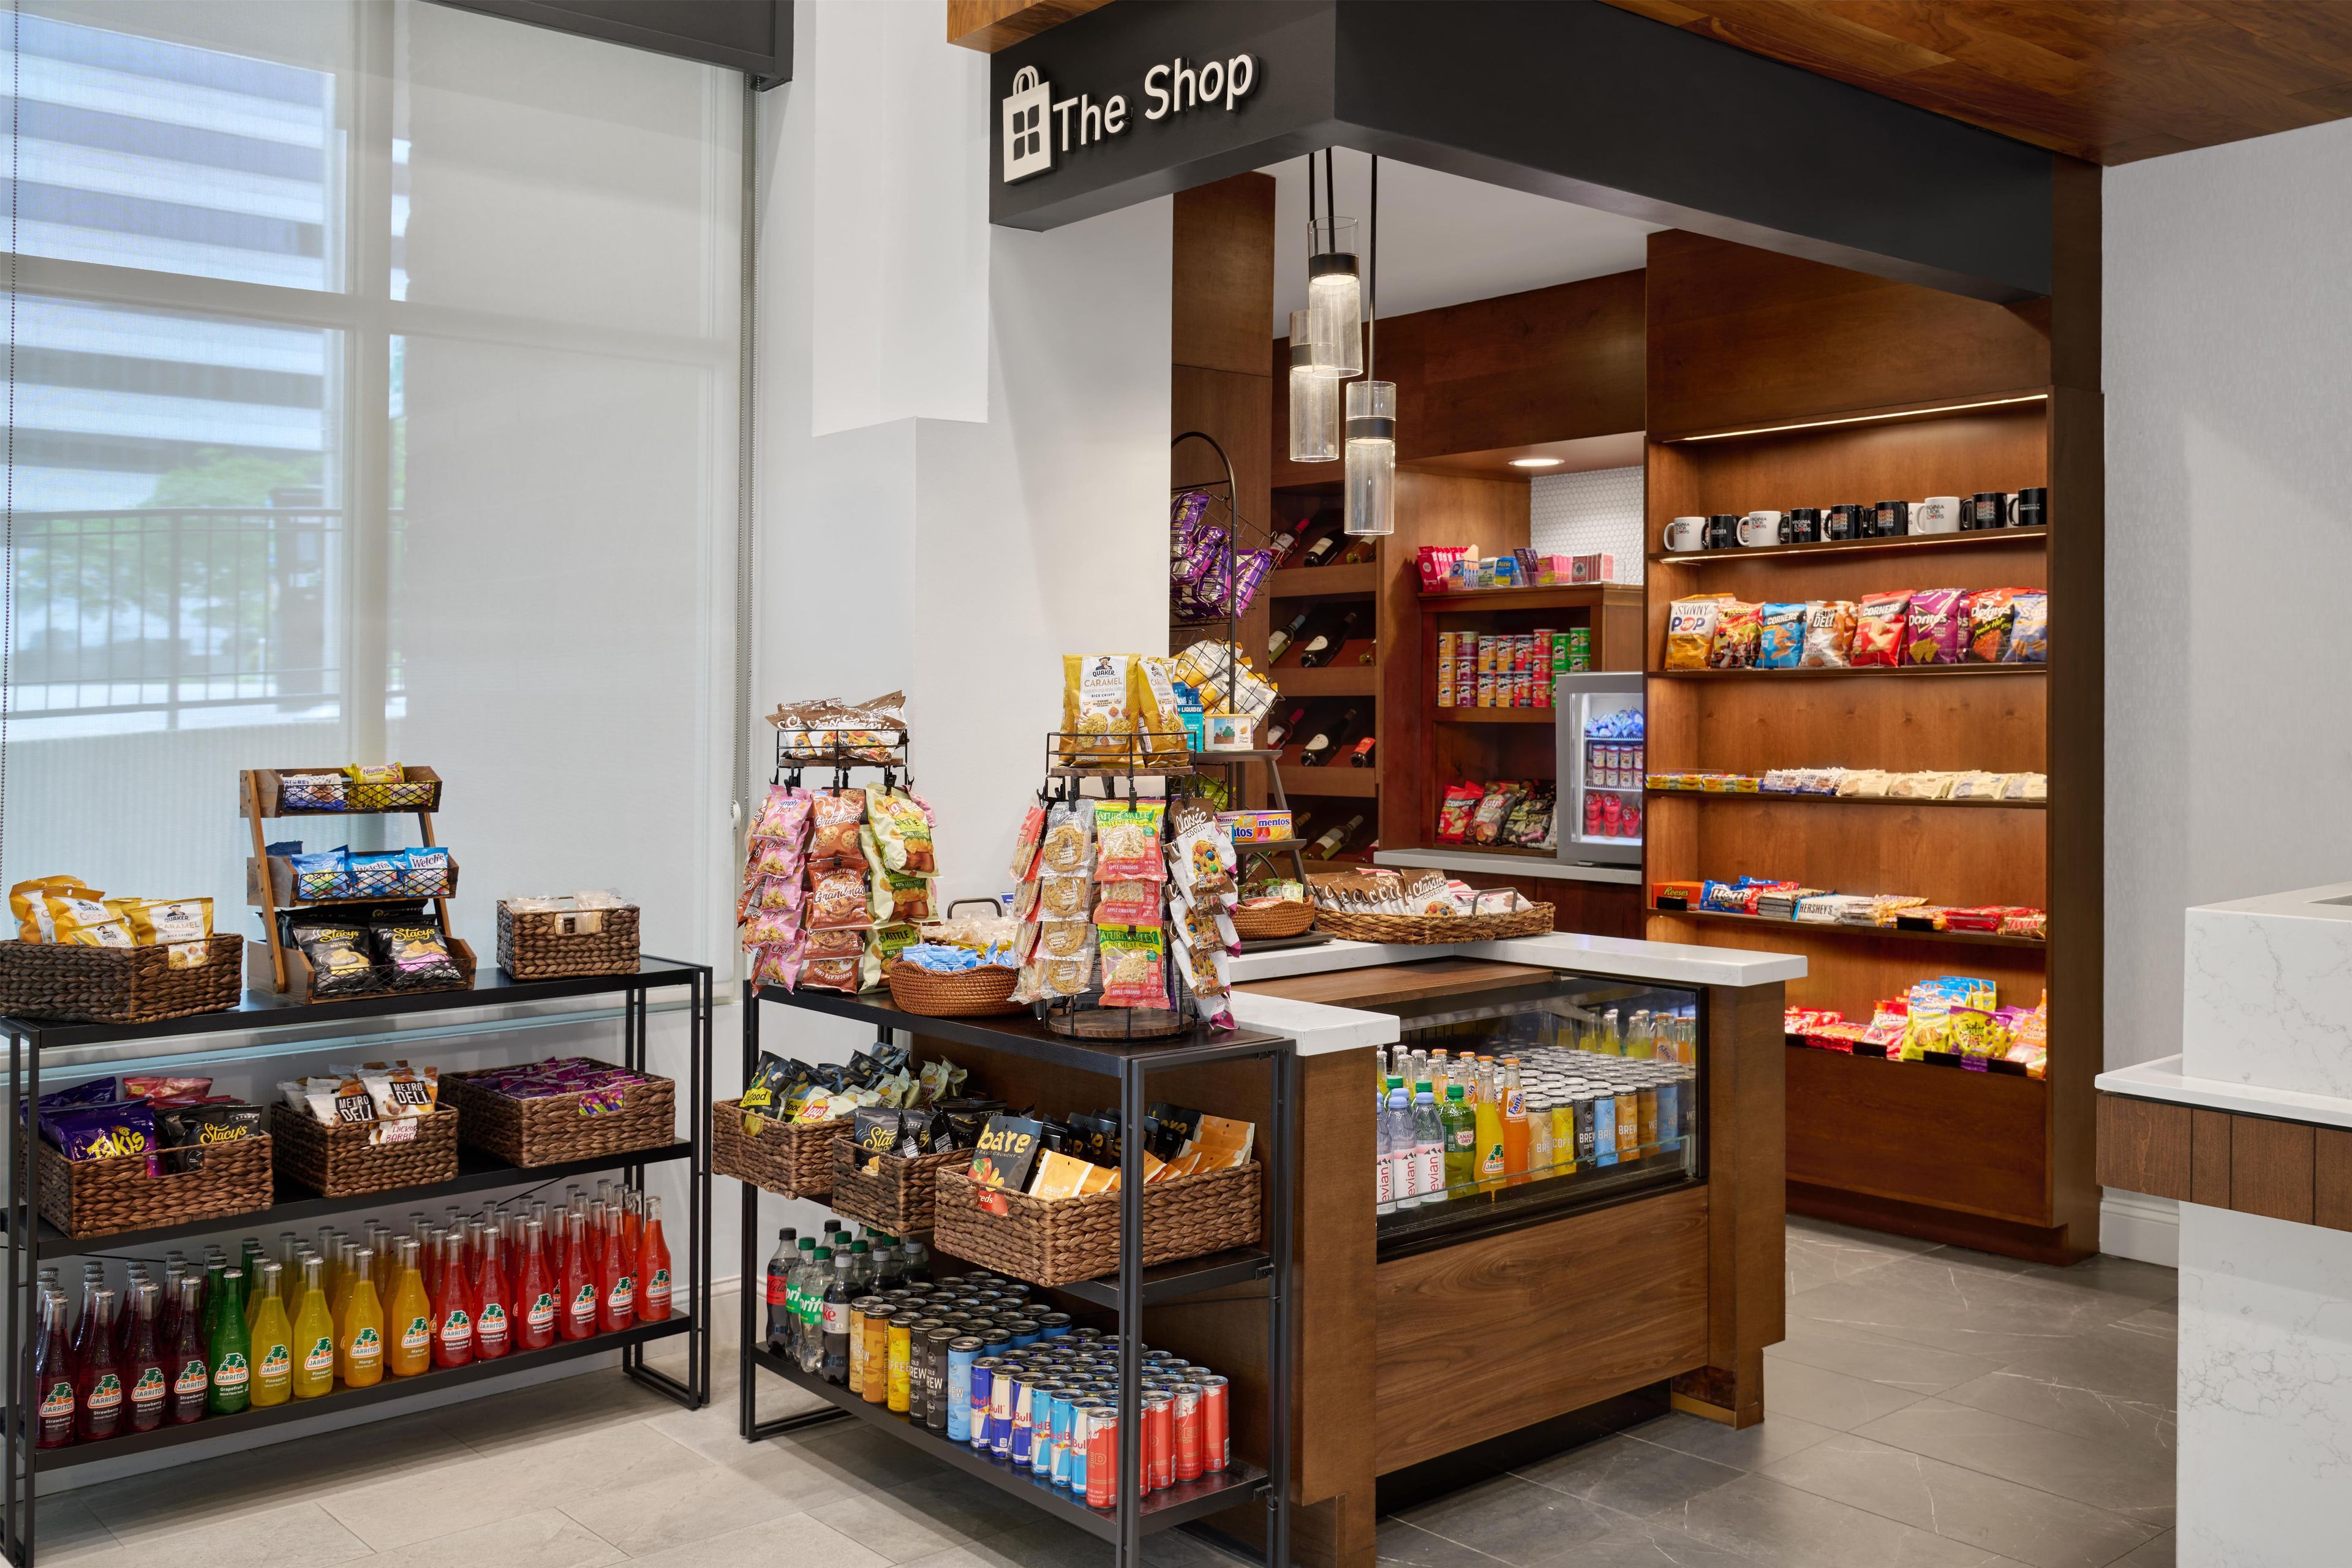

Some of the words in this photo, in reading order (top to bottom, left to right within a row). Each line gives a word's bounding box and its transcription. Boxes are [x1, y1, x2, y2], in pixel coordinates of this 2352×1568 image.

[1053, 93, 1128, 152] The
[1144, 54, 1254, 120] Shop
[1676, 604, 1709, 616] SKINNY
[1671, 616, 1705, 631] POP
[1909, 613, 1948, 627] Doritos
[1084, 677, 1122, 687] CARAMEL
[1481, 797, 1504, 809] Lay's
[1175, 807, 1207, 834] Classic
[1257, 818, 1290, 827] mentos
[767, 840, 786, 849] Chex
[412, 854, 445, 867] Welch's
[356, 861, 390, 872] Welch's
[1412, 876, 1446, 897] Classic
[1664, 886, 1689, 897] Reese's
[813, 885, 865, 904] Grandma's
[1423, 890, 1441, 900] COOKIE
[1799, 903, 1833, 914] HERSHEY'S
[318, 929, 359, 943] Stacy's
[393, 927, 435, 942] Stacy's
[884, 930, 910, 940] KETTLE
[771, 944, 790, 954] Chex
[393, 1083, 423, 1091] METRO
[339, 1095, 369, 1109] METRO
[1508, 1093, 1523, 1115] Fanta
[803, 1105, 827, 1119] Lay's
[200, 1123, 247, 1144] Stacy's
[1618, 1125, 1637, 1135] BREW
[977, 1123, 1031, 1153] bare
[1553, 1138, 1574, 1148] COFFE
[87, 1131, 145, 1159] Takis
[1406, 1161, 1415, 1196] evian
[1428, 1156, 1439, 1191] evian
[1379, 1166, 1389, 1202] evian
[443, 1328, 470, 1336] JARRITOS
[352, 1346, 380, 1355] JARRITOS
[262, 1363, 289, 1373] JARRITOS
[217, 1371, 246, 1381] JARRITOS
[178, 1380, 206, 1390] JARRITOS
[135, 1387, 164, 1397] JARRITOS
[91, 1394, 121, 1404] JARRITOS
[971, 1395, 986, 1405] Red
[43, 1403, 73, 1413] JARRITOS
[1015, 1412, 1031, 1422] Bull
